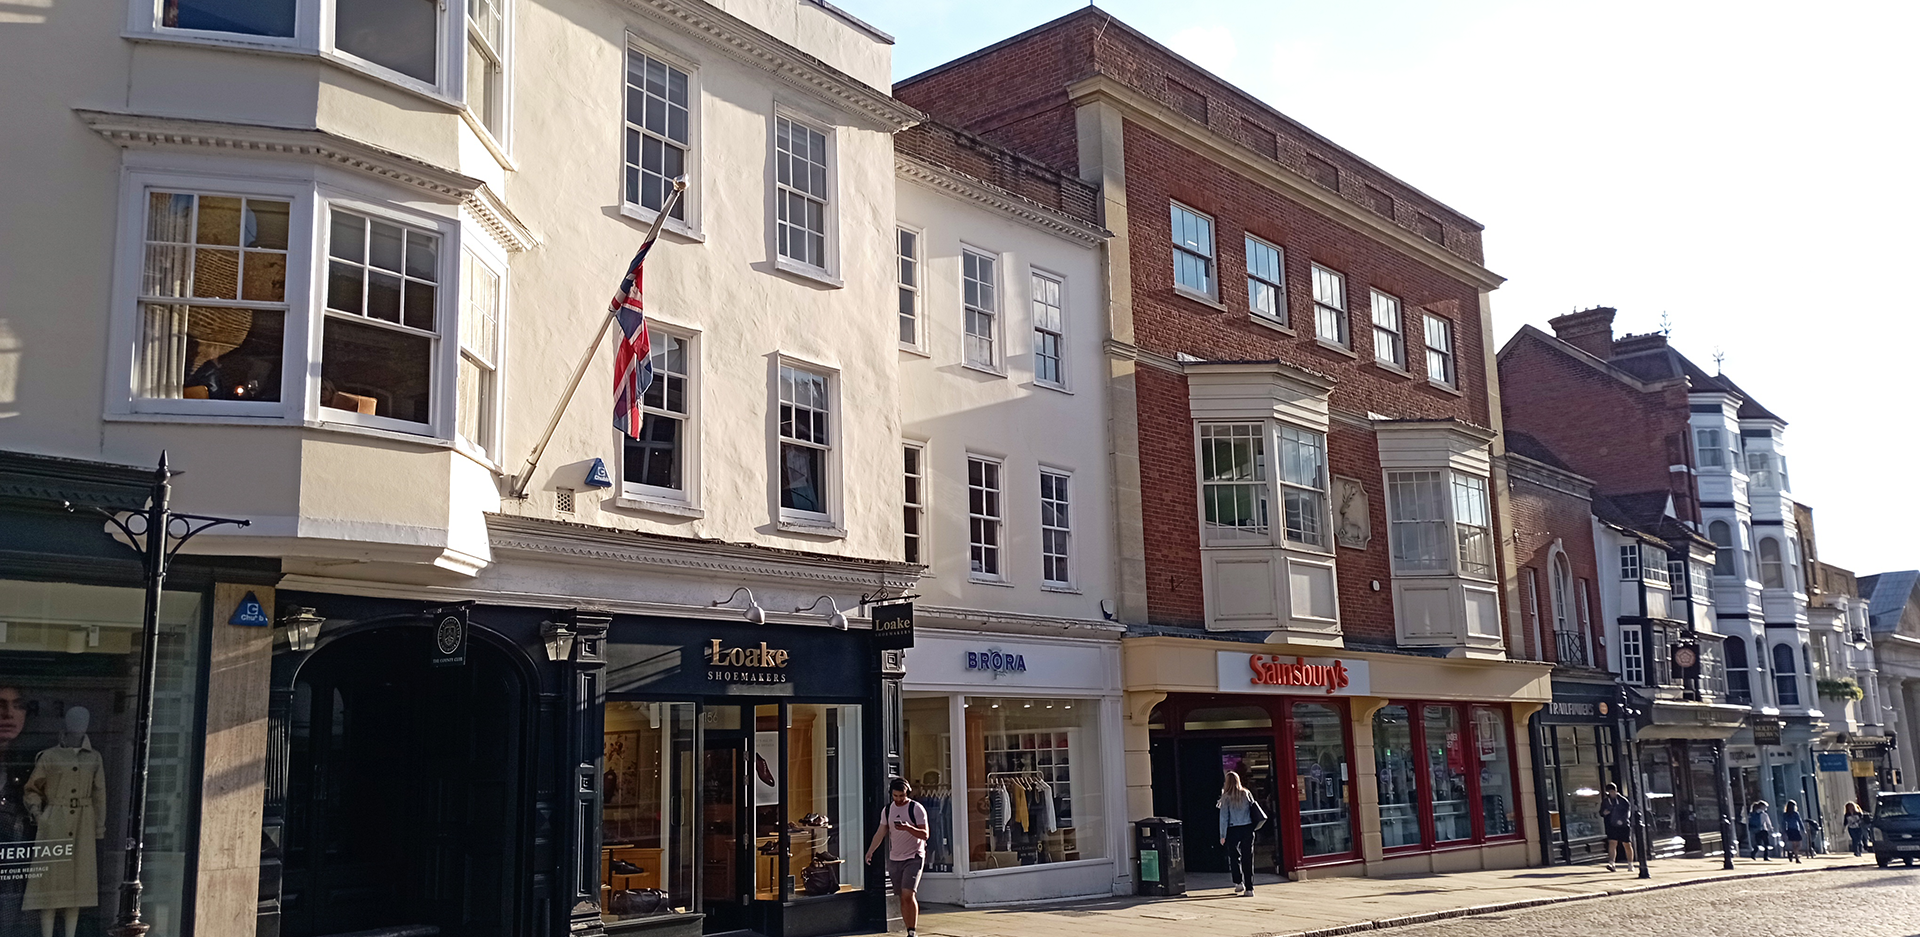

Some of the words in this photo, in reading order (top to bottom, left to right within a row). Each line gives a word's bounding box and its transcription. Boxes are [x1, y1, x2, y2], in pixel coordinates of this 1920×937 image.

[875, 617, 910, 631] Loake
[709, 638, 788, 668] Loake
[965, 651, 1027, 671] BRORA
[707, 671, 786, 682] SHOEMAKERS
[1249, 654, 1349, 690] Sainsbury's
